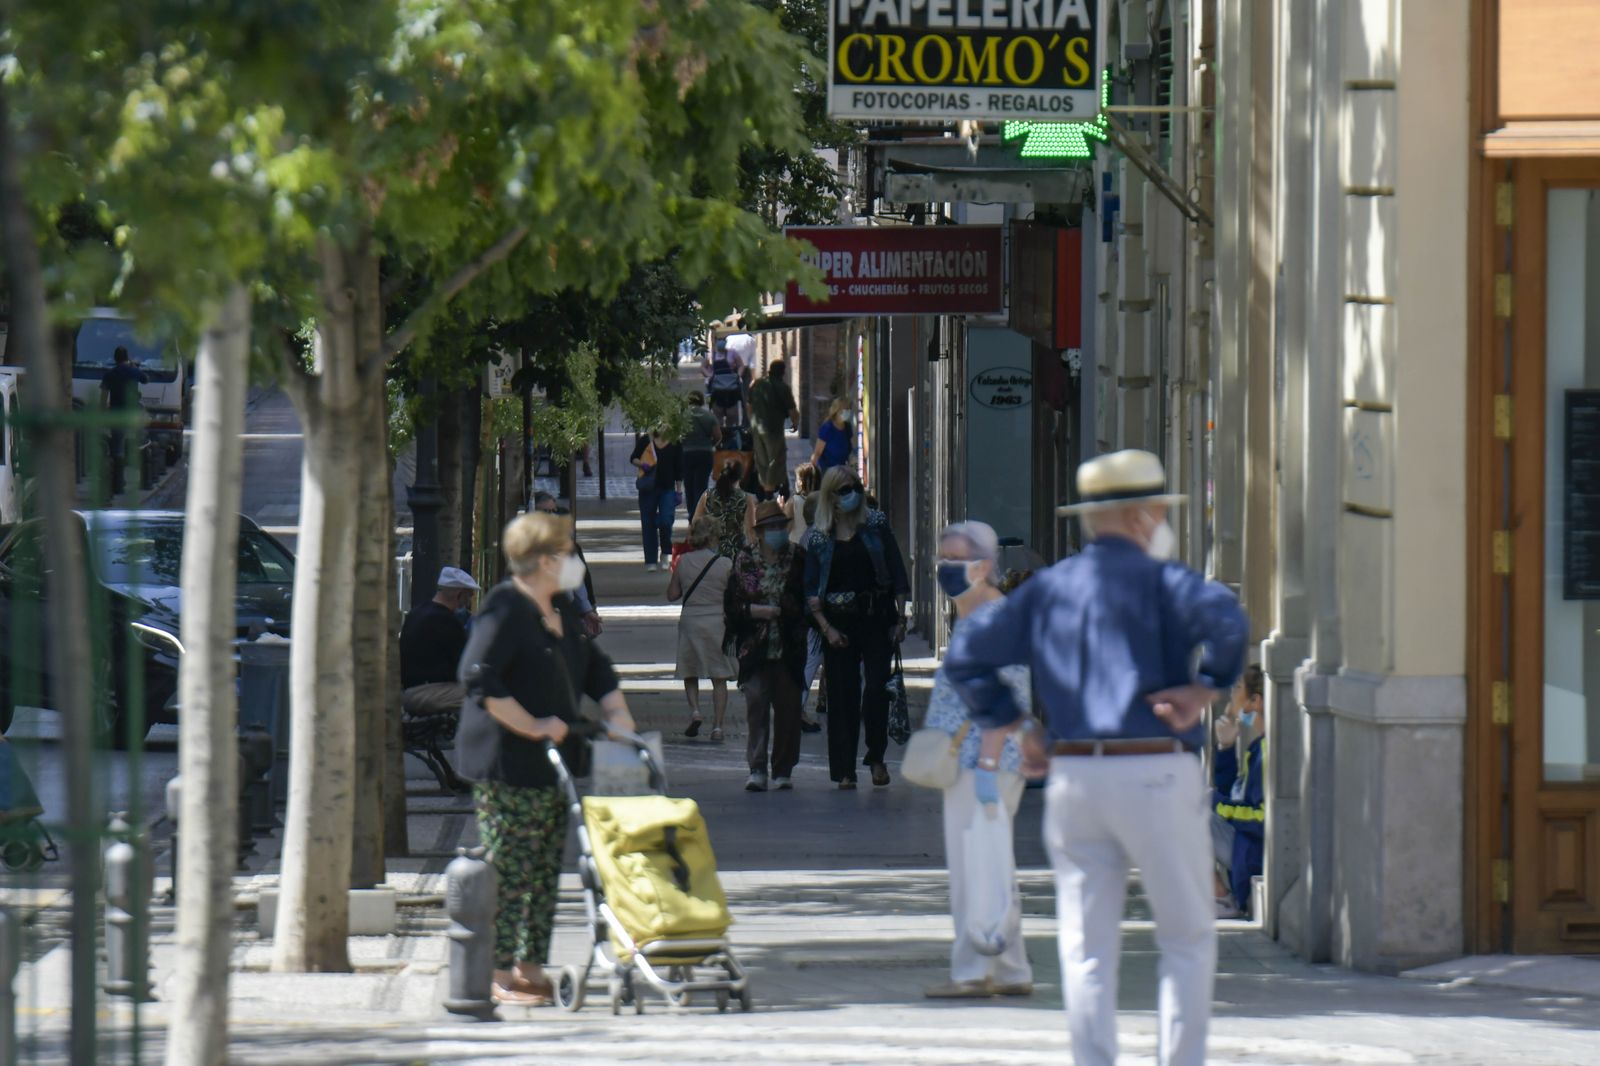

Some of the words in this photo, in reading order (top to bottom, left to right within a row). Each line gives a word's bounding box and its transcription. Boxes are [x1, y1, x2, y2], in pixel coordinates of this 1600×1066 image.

[852, 91, 970, 110] FOTOCOPIAS
[988, 93, 1074, 112] REGALOS
[858, 243, 988, 278] ALIMENTACIÓN
[849, 281, 909, 296] CHUCHERÍAS
[919, 283, 956, 296] FRUTOS
[958, 283, 989, 295] SECOS
